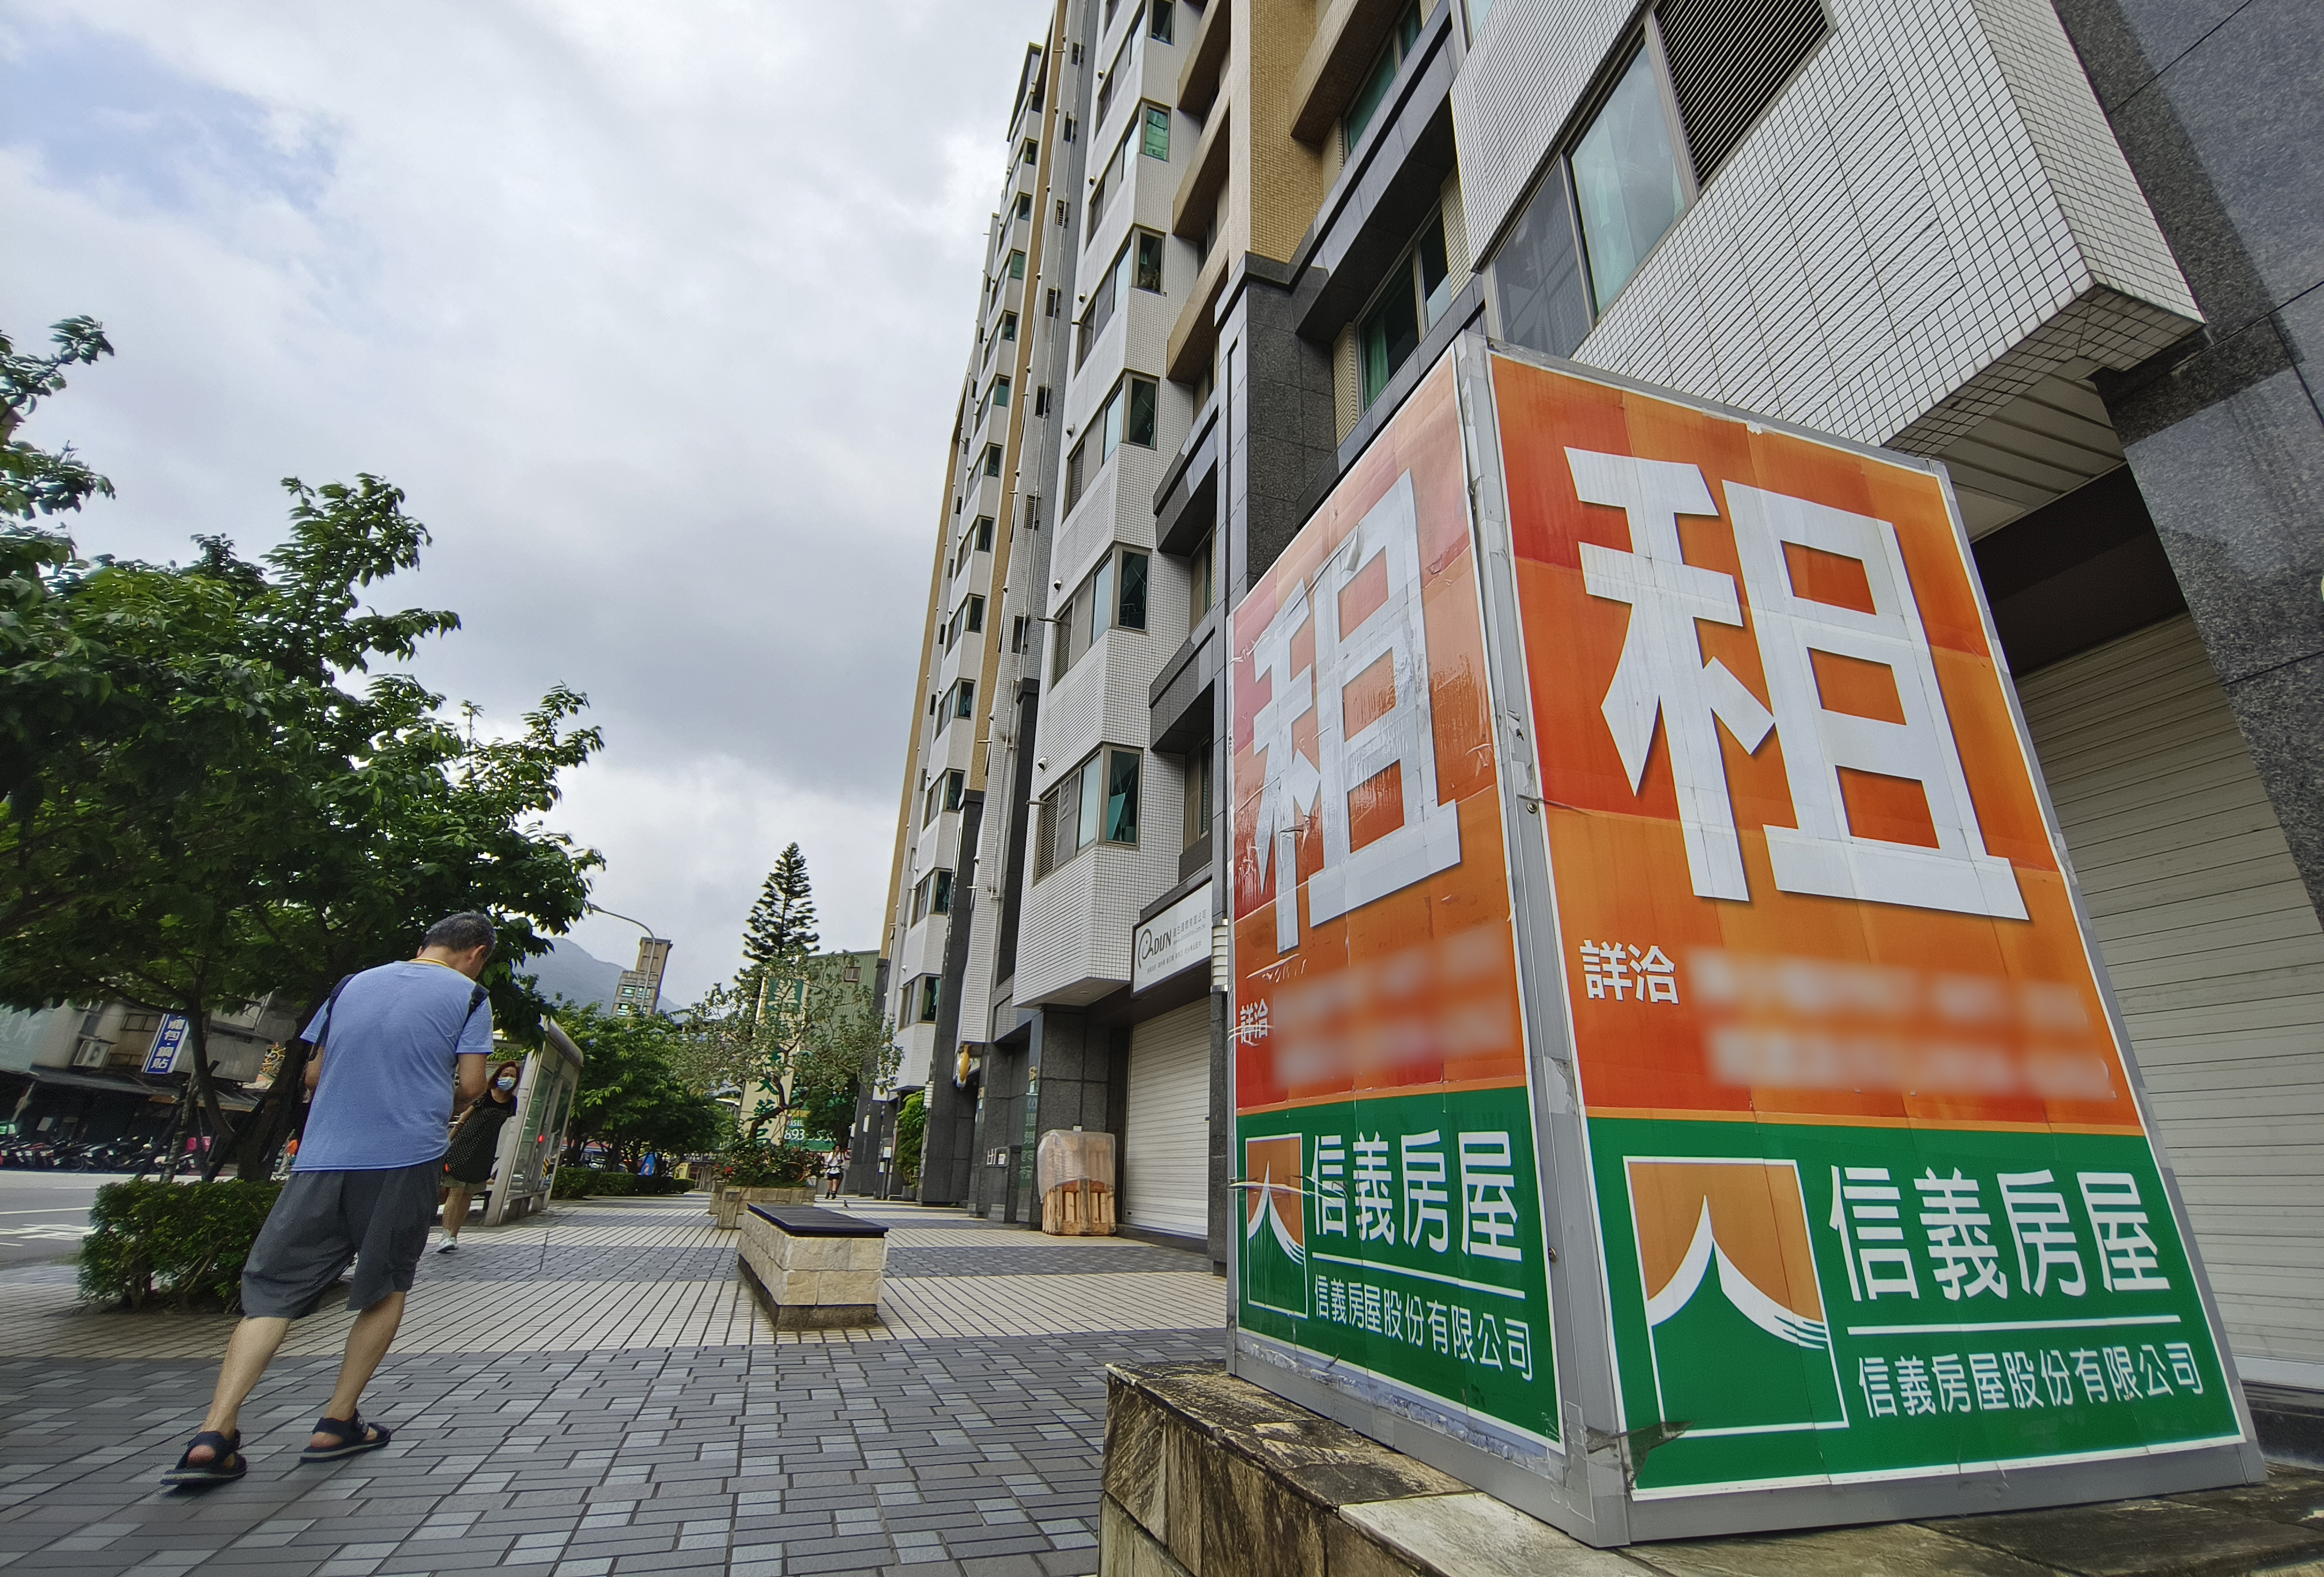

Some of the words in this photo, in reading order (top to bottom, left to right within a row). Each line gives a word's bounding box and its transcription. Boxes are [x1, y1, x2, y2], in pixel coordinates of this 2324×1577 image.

[1254, 468, 1462, 953] 租
[1563, 447, 2029, 920] 租
[1240, 998, 1269, 1044] 詳洽
[1579, 939, 1678, 1004] 詳洽
[1311, 1129, 1522, 1262] 信義房屋
[1829, 1165, 2171, 1301] 信義房屋
[1314, 1273, 1533, 1381] 信義房屋股份有限公司
[1858, 1341, 2204, 1418] 信義房屋股份有限公司
